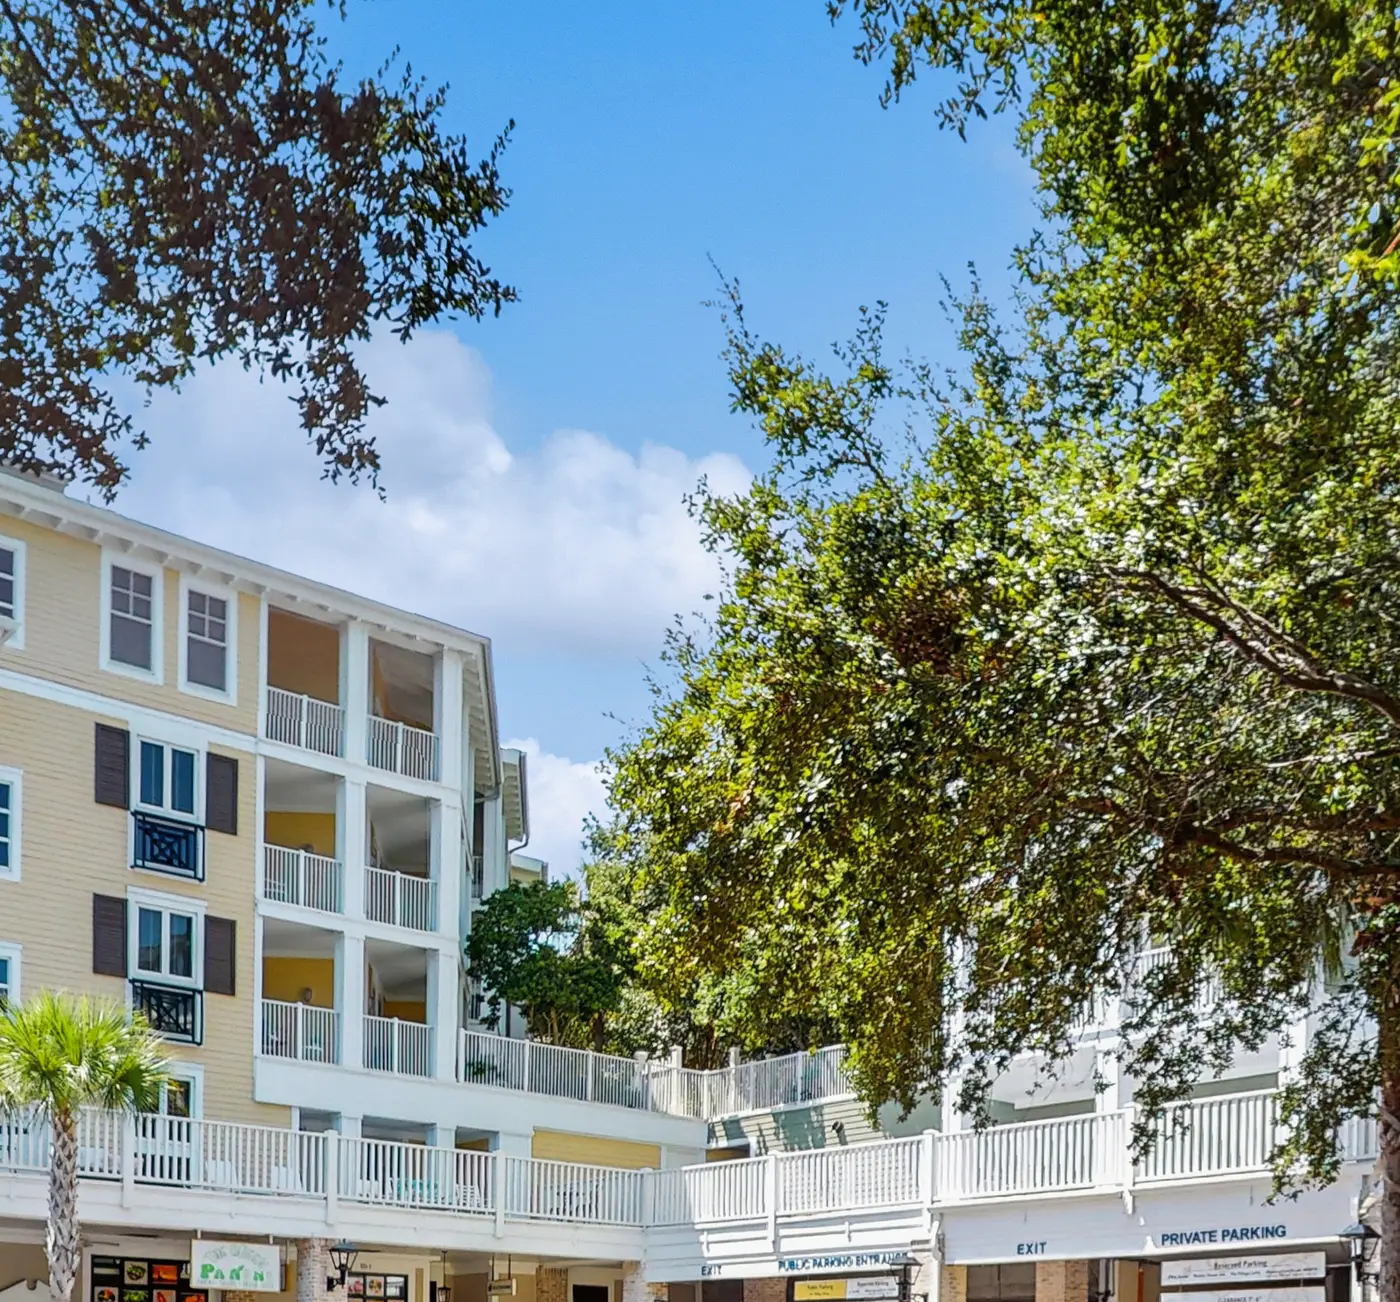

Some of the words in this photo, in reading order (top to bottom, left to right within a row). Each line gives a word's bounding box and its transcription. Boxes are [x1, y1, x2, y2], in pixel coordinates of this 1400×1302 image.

[1161, 1230, 1218, 1246] PRIVATE
[1221, 1225, 1287, 1241] PARKING
[1017, 1241, 1047, 1255] EXIT
[701, 1264, 723, 1276] EXIT
[778, 1257, 811, 1273] PUBLIC
[812, 1255, 854, 1269] PARKING
